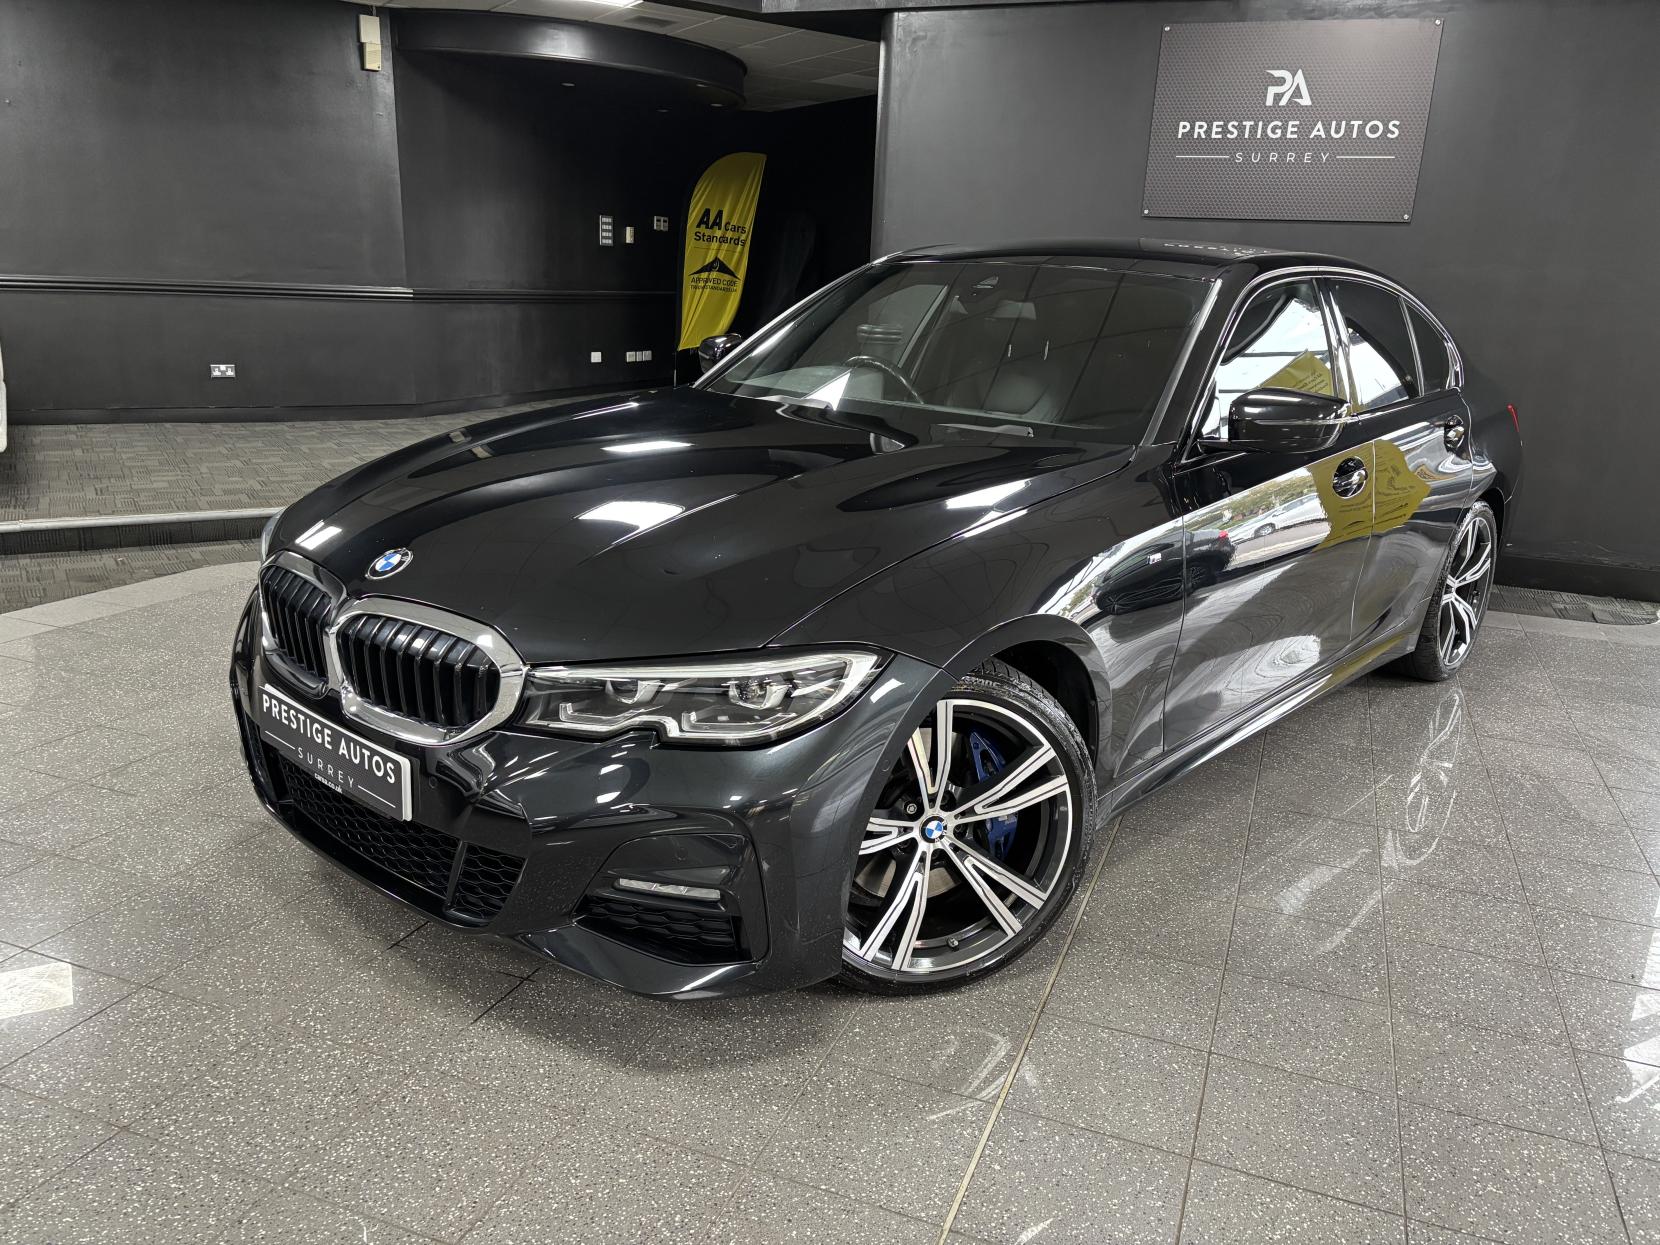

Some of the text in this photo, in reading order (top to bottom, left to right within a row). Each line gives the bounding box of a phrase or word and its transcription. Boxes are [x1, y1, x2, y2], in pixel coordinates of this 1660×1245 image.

[1265, 68, 1312, 106] PA
[1177, 120, 1401, 139] PRESTIGE AUTOS
[1235, 152, 1330, 163] SURREY
[696, 208, 747, 234] AA Cars
[694, 231, 746, 246] Standards
[262, 693, 396, 784] PRESTIGE AUTOS
[297, 746, 355, 789] SURREY
